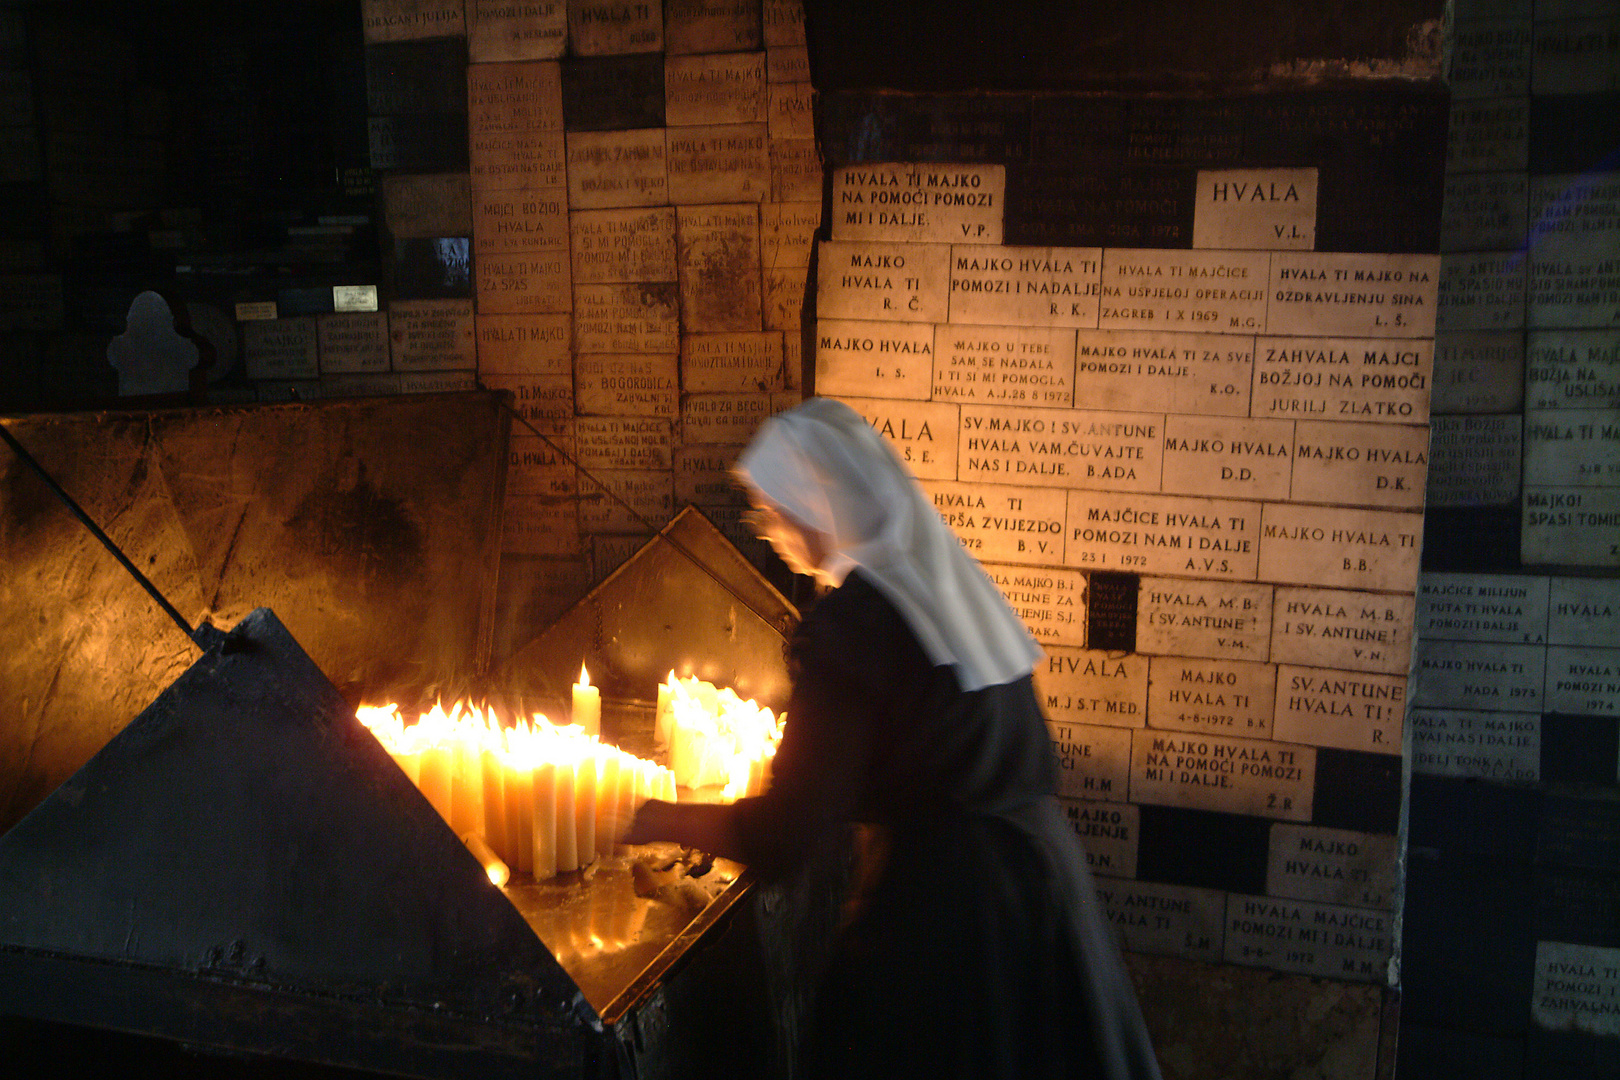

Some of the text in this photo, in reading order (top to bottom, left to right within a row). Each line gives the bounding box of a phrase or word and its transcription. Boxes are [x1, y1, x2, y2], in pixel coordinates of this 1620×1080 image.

[844, 173, 980, 188] HVALA TI MAJKO
[841, 190, 992, 206] NA POMOĆI POMOZI
[1213, 183, 1298, 203] HVALA
[850, 255, 906, 267] MAJKO
[955, 258, 1096, 274] MAJKO HVALA TI
[1118, 264, 1162, 278] HVALA
[1170, 266, 1182, 278] TI
[1279, 269, 1428, 282] HVALA TI MAJKO NA
[841, 276, 920, 290] HVALA TI
[950, 279, 1101, 296] POMOZI NADALJE
[1101, 286, 1263, 301] NA USPJELOJ OPERACIJI
[1275, 291, 1423, 305] OZDRAVLJENJU SINA
[1100, 307, 1218, 322] ZAGREB 1969
[820, 337, 933, 354] MAJKO HVALA
[954, 341, 1050, 354] MAJKO U TEBE
[950, 356, 1053, 369] SAM NADALA
[1079, 346, 1253, 364] MAJKO HVALA TI ZA SVE
[1266, 349, 1419, 366] ZAHVALA MAJCI
[1528, 348, 1576, 364] HVALA
[1078, 362, 1132, 374] POMOZI
[1527, 366, 1596, 383] BOŽJA NA
[948, 370, 1065, 386] TI MI POMOGLA
[1259, 368, 1322, 387] BOŽJOJ
[1328, 372, 1353, 388] NA
[932, 386, 1072, 403] HVALA 1972
[1268, 398, 1412, 416] JURILJ ZLATKO
[1526, 424, 1594, 440] HVALA TI
[967, 438, 1020, 453] HVALA
[1163, 438, 1287, 456] MAJKO HVALA
[1297, 445, 1424, 464] MAJKO HVALA
[968, 458, 999, 471] NAS
[934, 494, 1023, 511] HVALA TI
[982, 516, 1062, 534] ZVIJEZDO
[1087, 504, 1245, 532] MAJČICE HVALA TI
[1530, 513, 1572, 525] SPASI
[1073, 528, 1252, 554] POMOZI NAM DALJE
[1263, 524, 1414, 547] MAJKO HVALA TI
[1120, 554, 1147, 566] 1972
[1151, 593, 1207, 607] HVALA
[1478, 588, 1527, 597] MILIJUN
[1286, 601, 1347, 618] HVALA
[1466, 605, 1477, 614] TI
[1481, 606, 1522, 616] HVALA
[1557, 605, 1612, 616] HVALA
[1427, 619, 1518, 631] POMOZI DALJE
[1048, 655, 1126, 678] HVALA
[1420, 658, 1523, 672] MAJKO HVALA TI
[1568, 665, 1610, 675] HVALA
[1180, 671, 1237, 685] MAJKO
[1463, 685, 1499, 696] NADA
[1556, 681, 1602, 692] POMOZI
[1169, 690, 1250, 708] HVALA TI
[1288, 696, 1353, 717] HVALA
[1584, 700, 1614, 710] 1974
[1484, 720, 1534, 731] MAJKO
[1151, 739, 1297, 766] MAJKO HVALA TI
[1144, 751, 1301, 780] NA POMOĆI POMOZI
[1479, 767, 1534, 779] VLADO
[1548, 963, 1620, 982] HVALA TI
[1546, 981, 1601, 995] POMOZI
